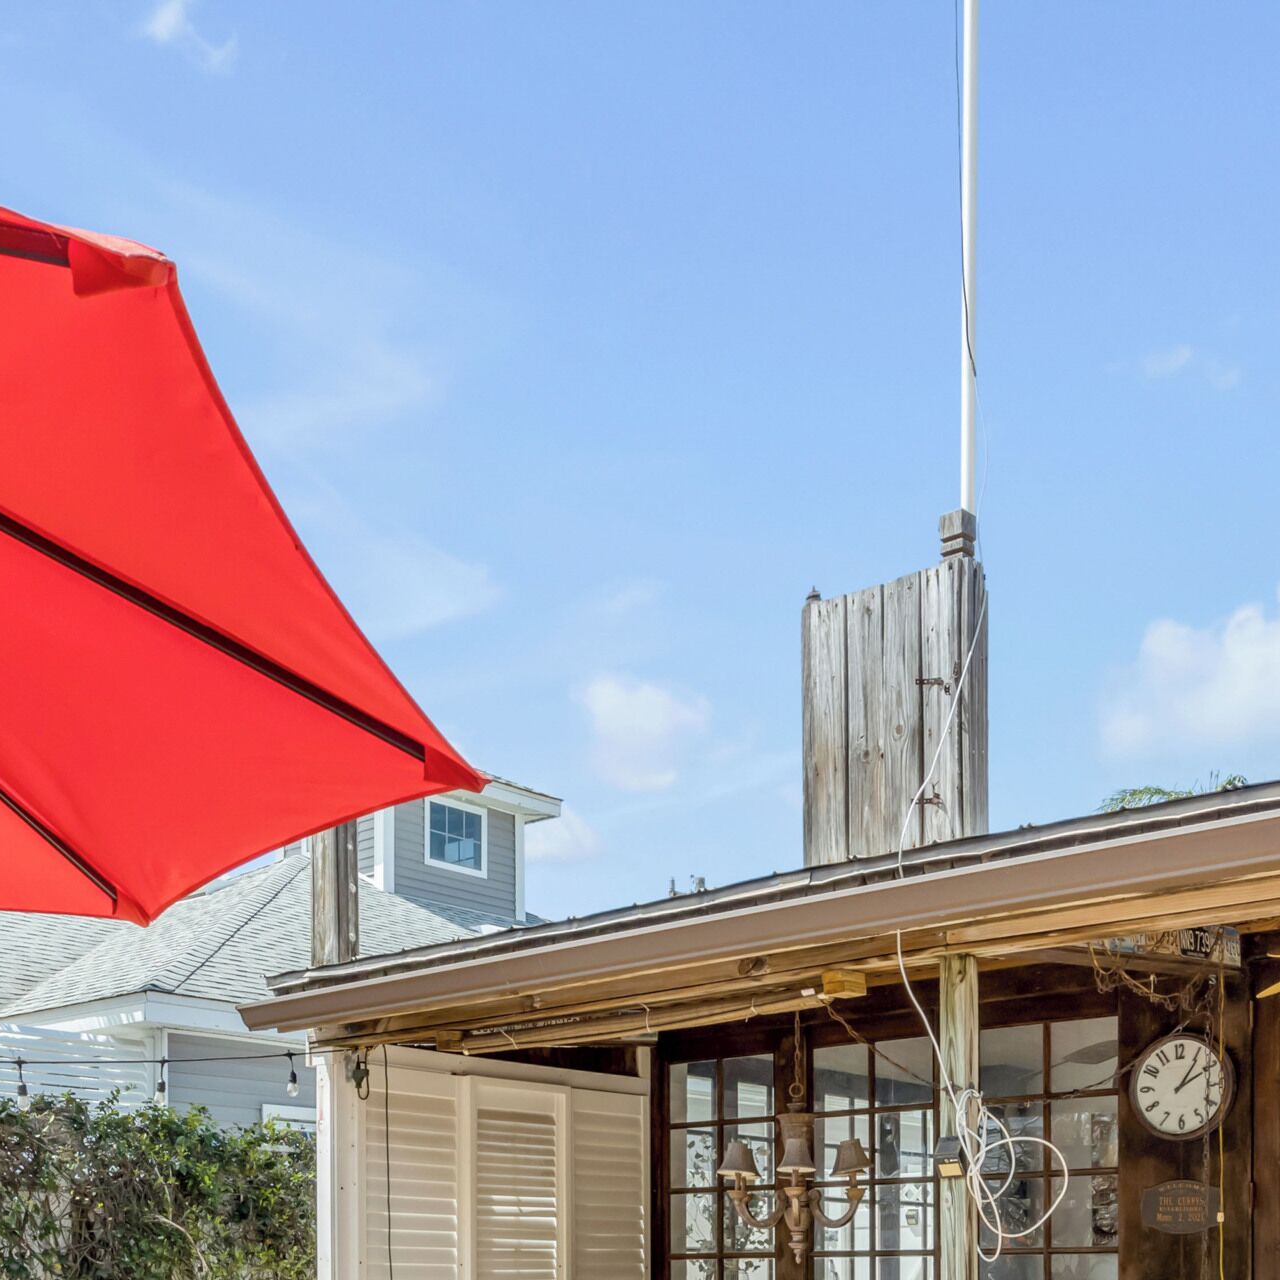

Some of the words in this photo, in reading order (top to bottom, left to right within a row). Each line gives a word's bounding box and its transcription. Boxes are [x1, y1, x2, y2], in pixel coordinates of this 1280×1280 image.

[1155, 1049, 1170, 1066] 11
[1174, 1043, 1185, 1060] 12
[1143, 1064, 1160, 1079] 10
[1139, 1086, 1156, 1094] 9
[1145, 1100, 1160, 1112] 8
[1159, 1111, 1171, 1126] 7
[1177, 1113, 1185, 1130] 6
[1193, 1108, 1204, 1124] 5
